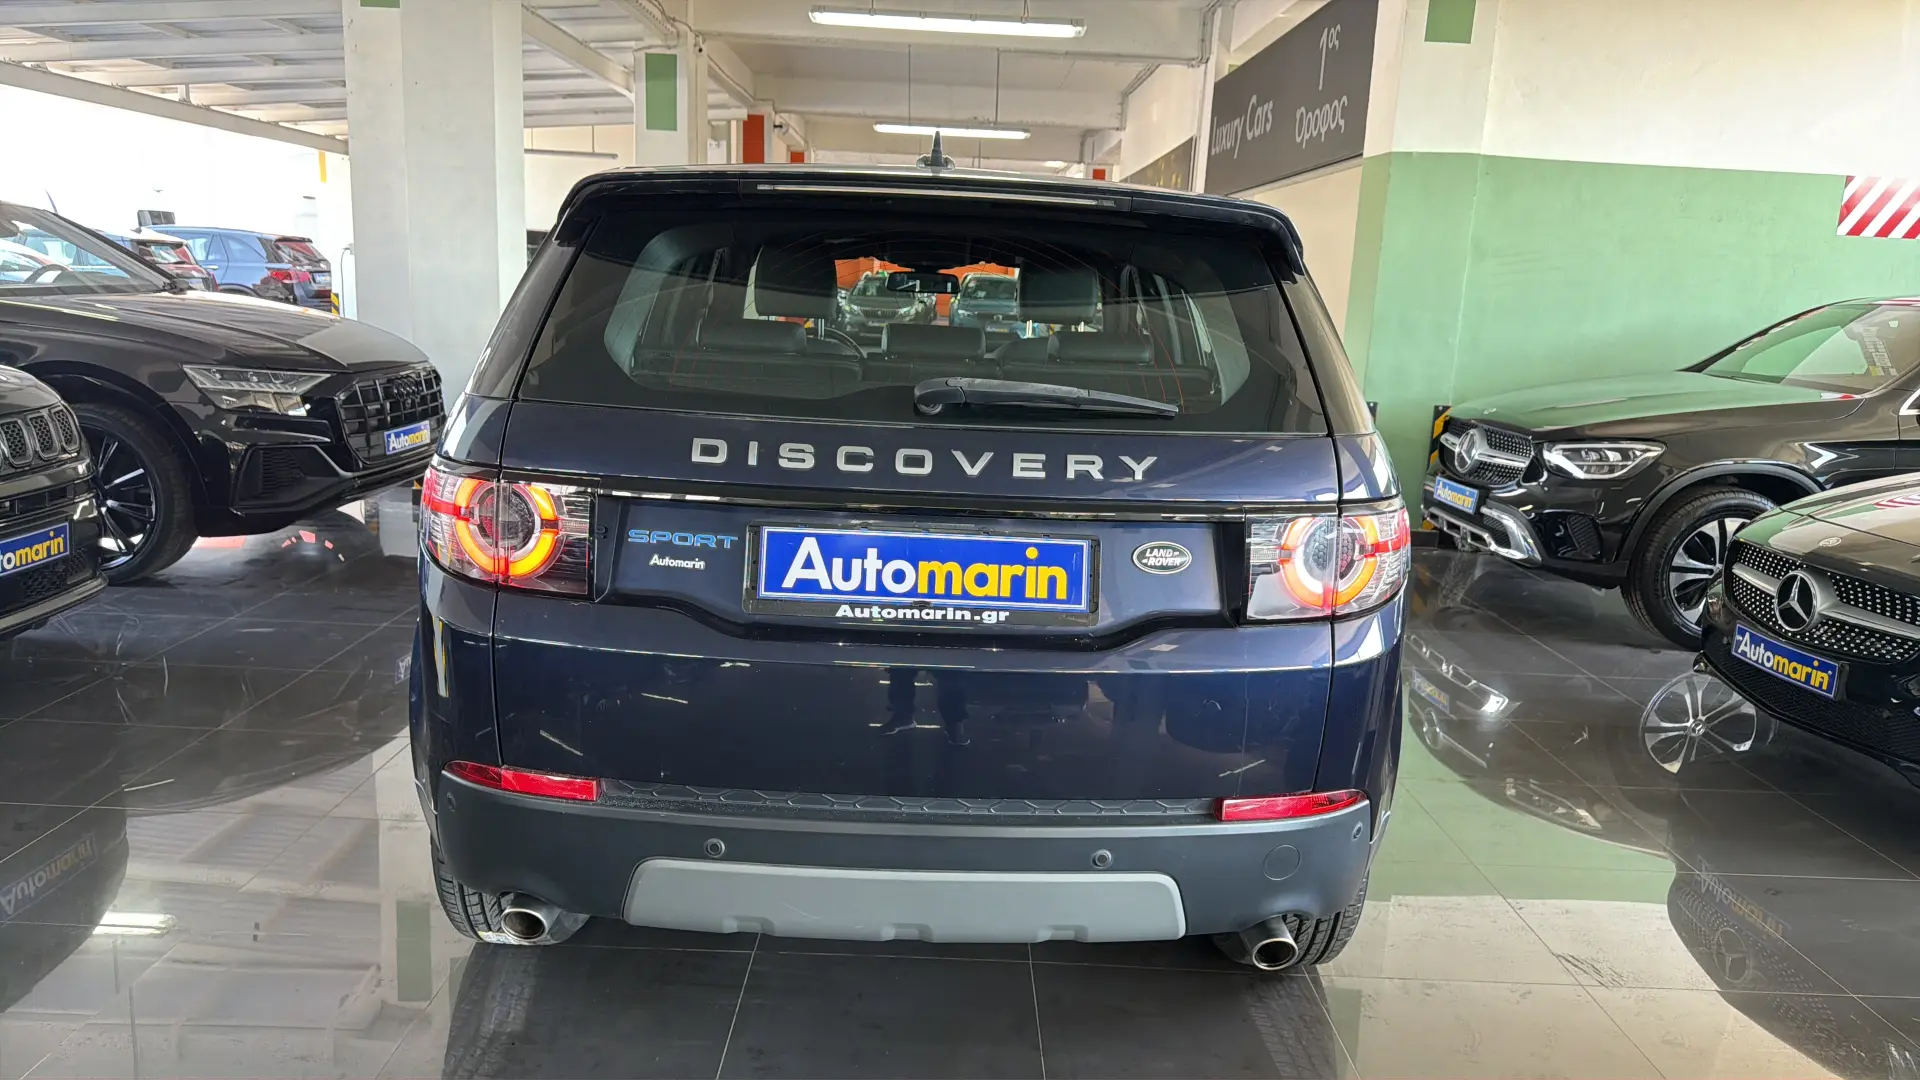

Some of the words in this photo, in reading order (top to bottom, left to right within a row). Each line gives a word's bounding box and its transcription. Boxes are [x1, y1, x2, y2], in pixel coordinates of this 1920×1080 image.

[1211, 115, 1245, 159] Luxury
[1246, 94, 1274, 141] Cars
[691, 437, 1158, 481] DISCOVERY
[628, 529, 739, 549] SPORT
[649, 553, 705, 570] Automarin
[1145, 548, 1173, 558] LAND
[1147, 557, 1180, 567] ROVER
[781, 536, 1068, 600] Automarin
[835, 604, 1010, 624] Automarin.gr
[1738, 631, 1830, 690] Automarin
